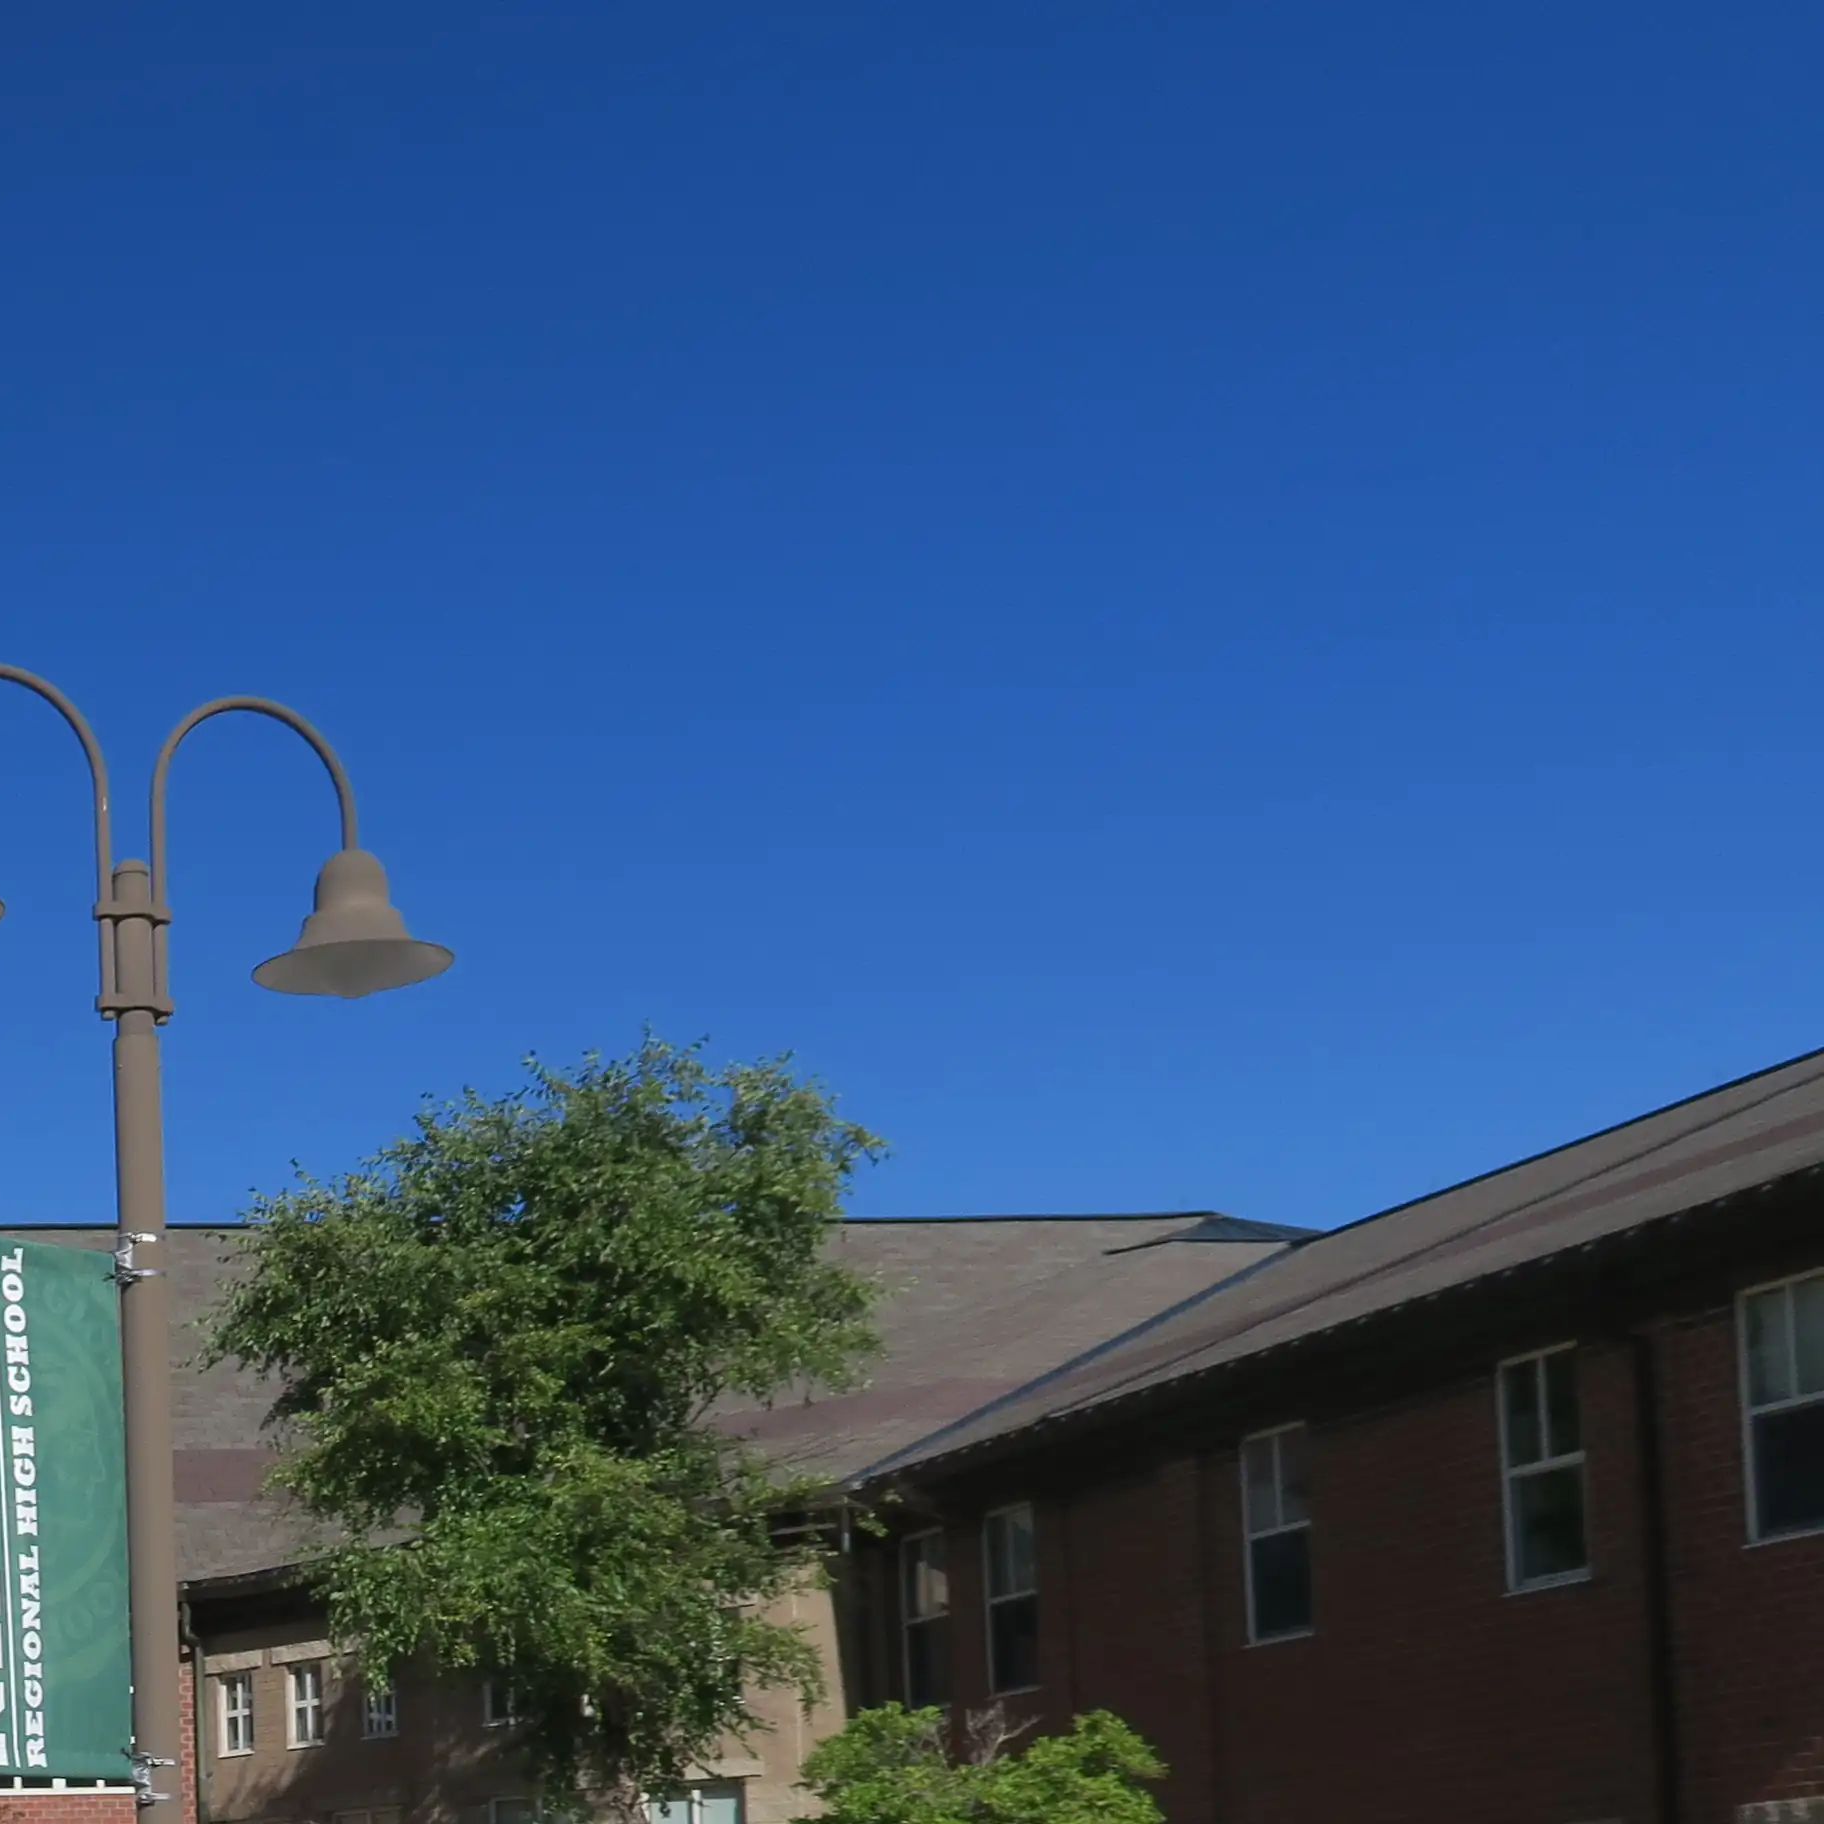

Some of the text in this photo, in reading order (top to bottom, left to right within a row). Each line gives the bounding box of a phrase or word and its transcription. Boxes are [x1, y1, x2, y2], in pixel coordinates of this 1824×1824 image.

[1, 1247, 48, 1768] REGIONAL HIGH SCHOOL
